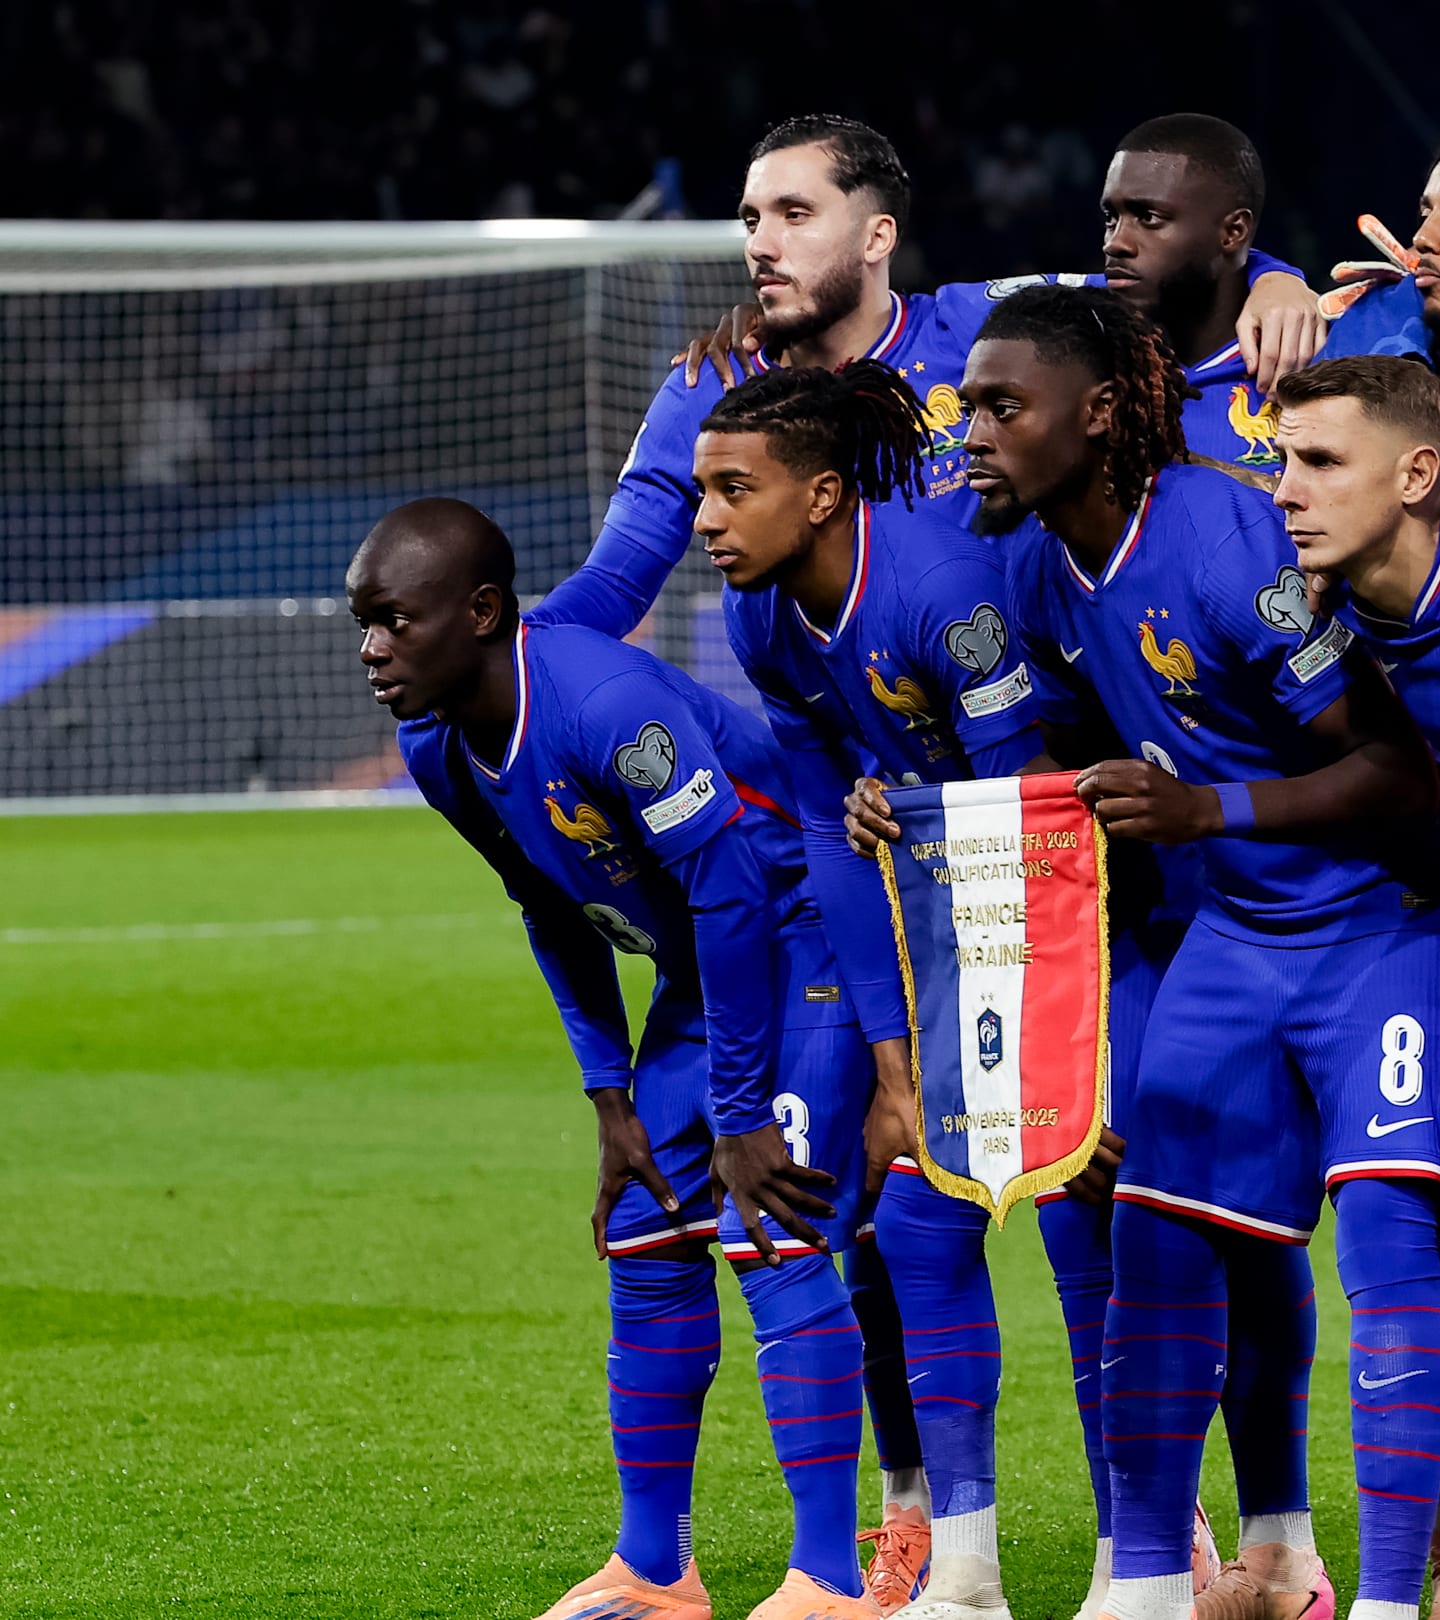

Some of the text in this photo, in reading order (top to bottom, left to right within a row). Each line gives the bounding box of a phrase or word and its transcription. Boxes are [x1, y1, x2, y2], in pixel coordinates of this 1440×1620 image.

[951, 837, 984, 856] MONDE
[987, 836, 1000, 853] DE
[1003, 835, 1016, 852] LA
[1020, 833, 1044, 851] FIFA
[1046, 831, 1078, 849] 2026
[933, 859, 1053, 885] QUALIFICATIONS
[952, 901, 1029, 928] FRANCE
[583, 903, 656, 953] 3
[955, 942, 1034, 969] UKRAINE
[1379, 1013, 1425, 1107] 8
[955, 1111, 1015, 1133] NOVEMBRE
[1020, 1107, 1059, 1128] 2025
[983, 1136, 1010, 1155] PARIS
